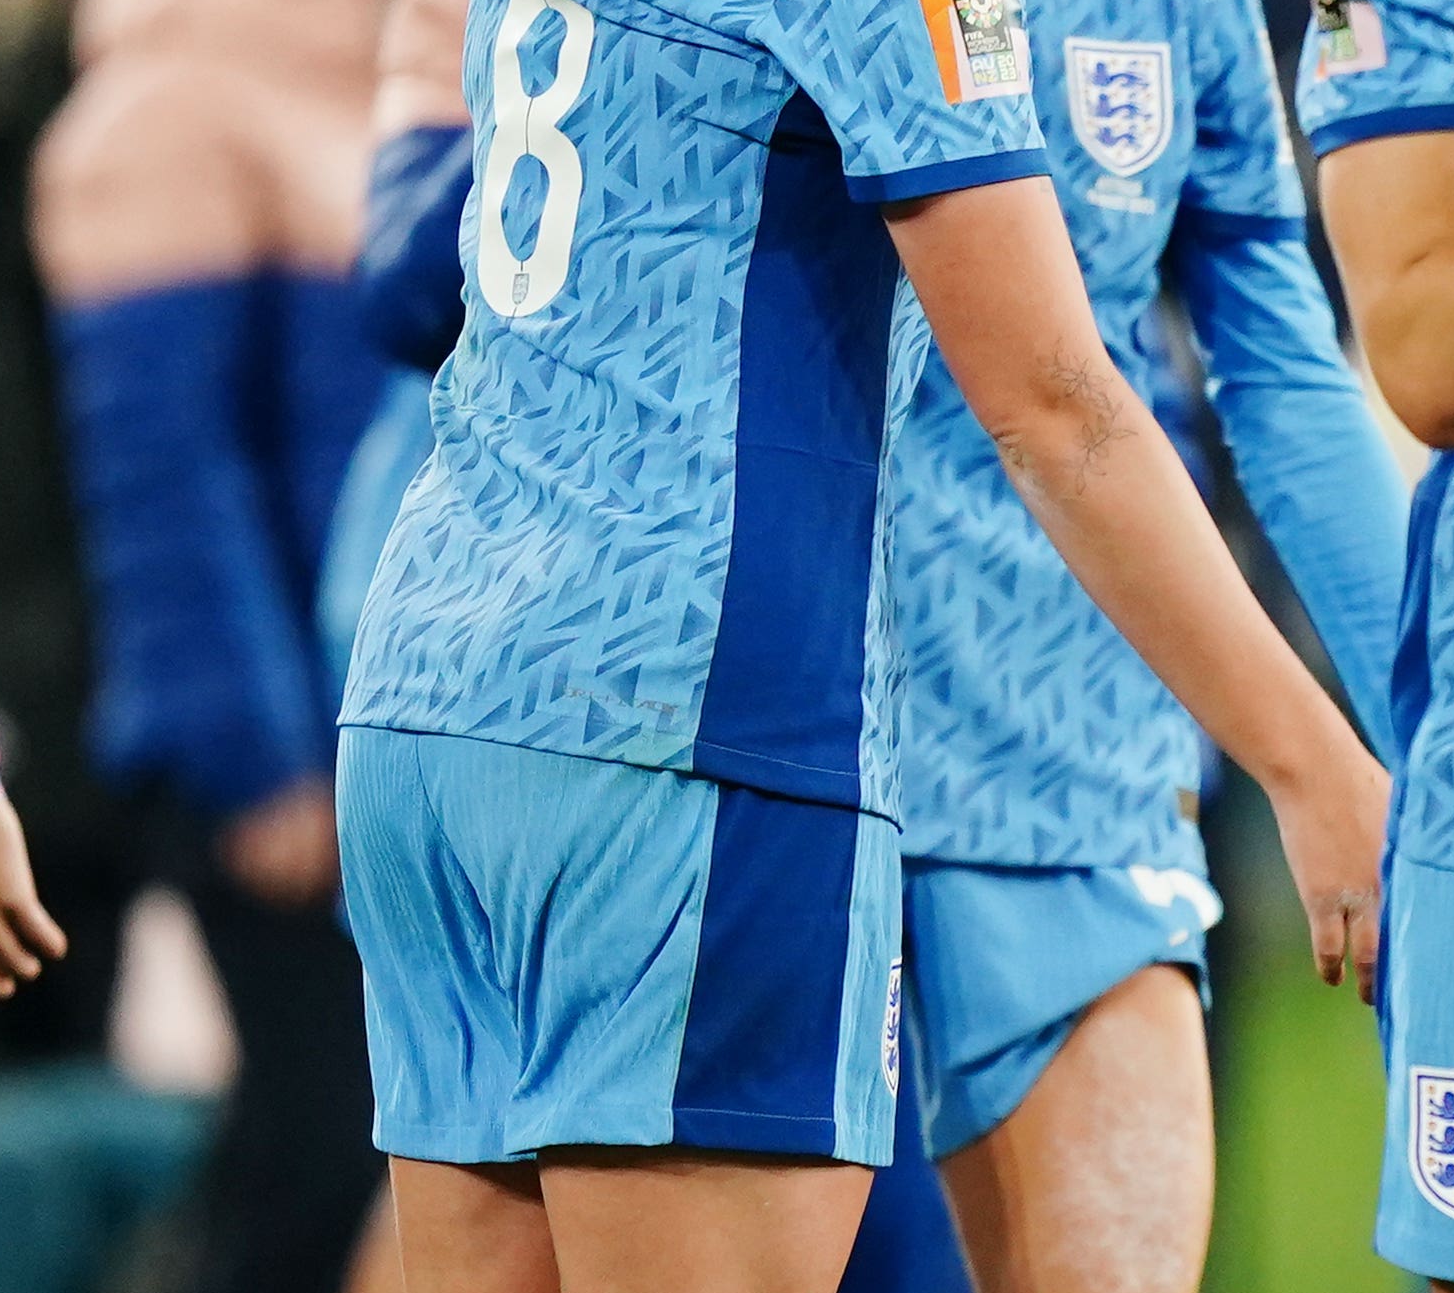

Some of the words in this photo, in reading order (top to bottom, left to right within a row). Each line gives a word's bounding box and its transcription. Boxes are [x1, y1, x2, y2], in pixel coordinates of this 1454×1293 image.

[965, 30, 984, 43] FIFA
[972, 54, 994, 72] AU
[997, 54, 1014, 68] 20
[999, 67, 1017, 81] 23
